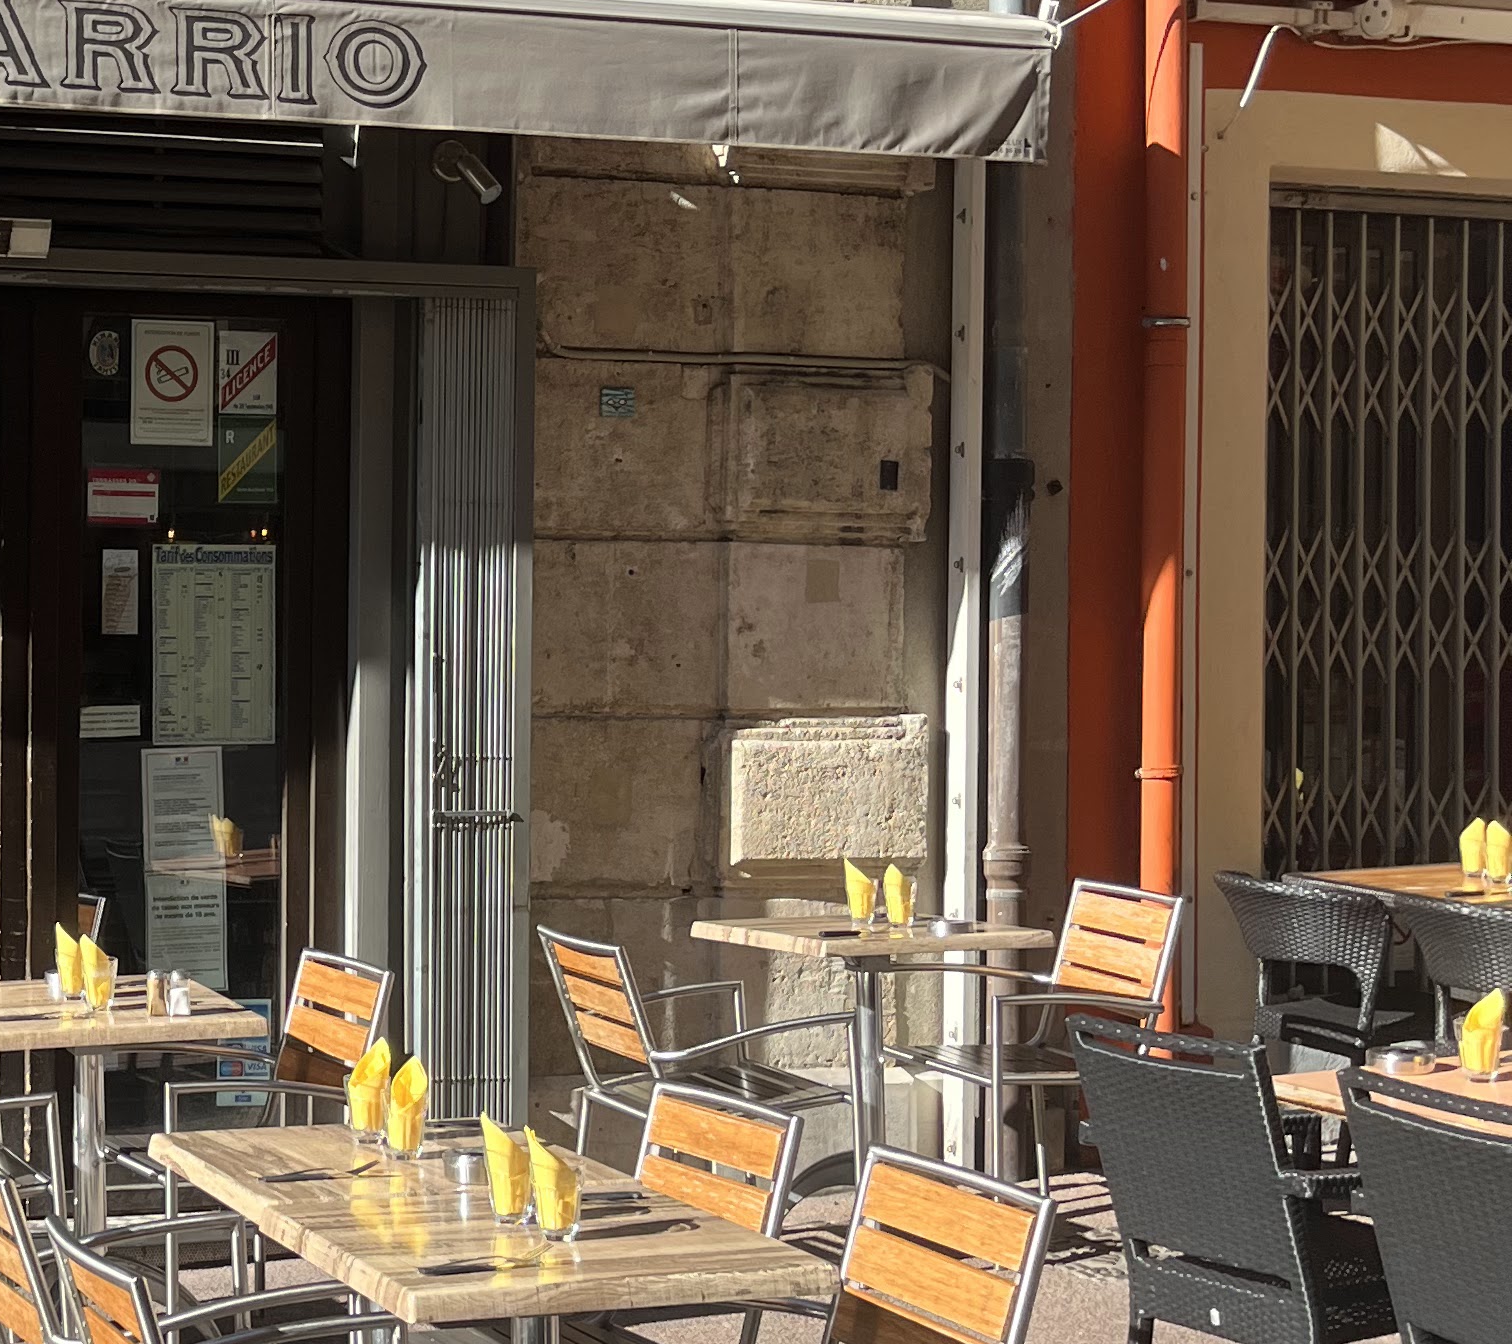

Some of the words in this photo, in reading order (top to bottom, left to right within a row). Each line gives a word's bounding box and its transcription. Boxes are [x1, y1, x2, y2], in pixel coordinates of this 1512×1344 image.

[225, 344, 272, 402] LICENCE
[225, 429, 235, 444] R
[221, 422, 275, 492] RESTAURANT
[155, 545, 181, 565] Tarif
[195, 545, 274, 565] Consommations
[247, 1062, 267, 1071] VISA
